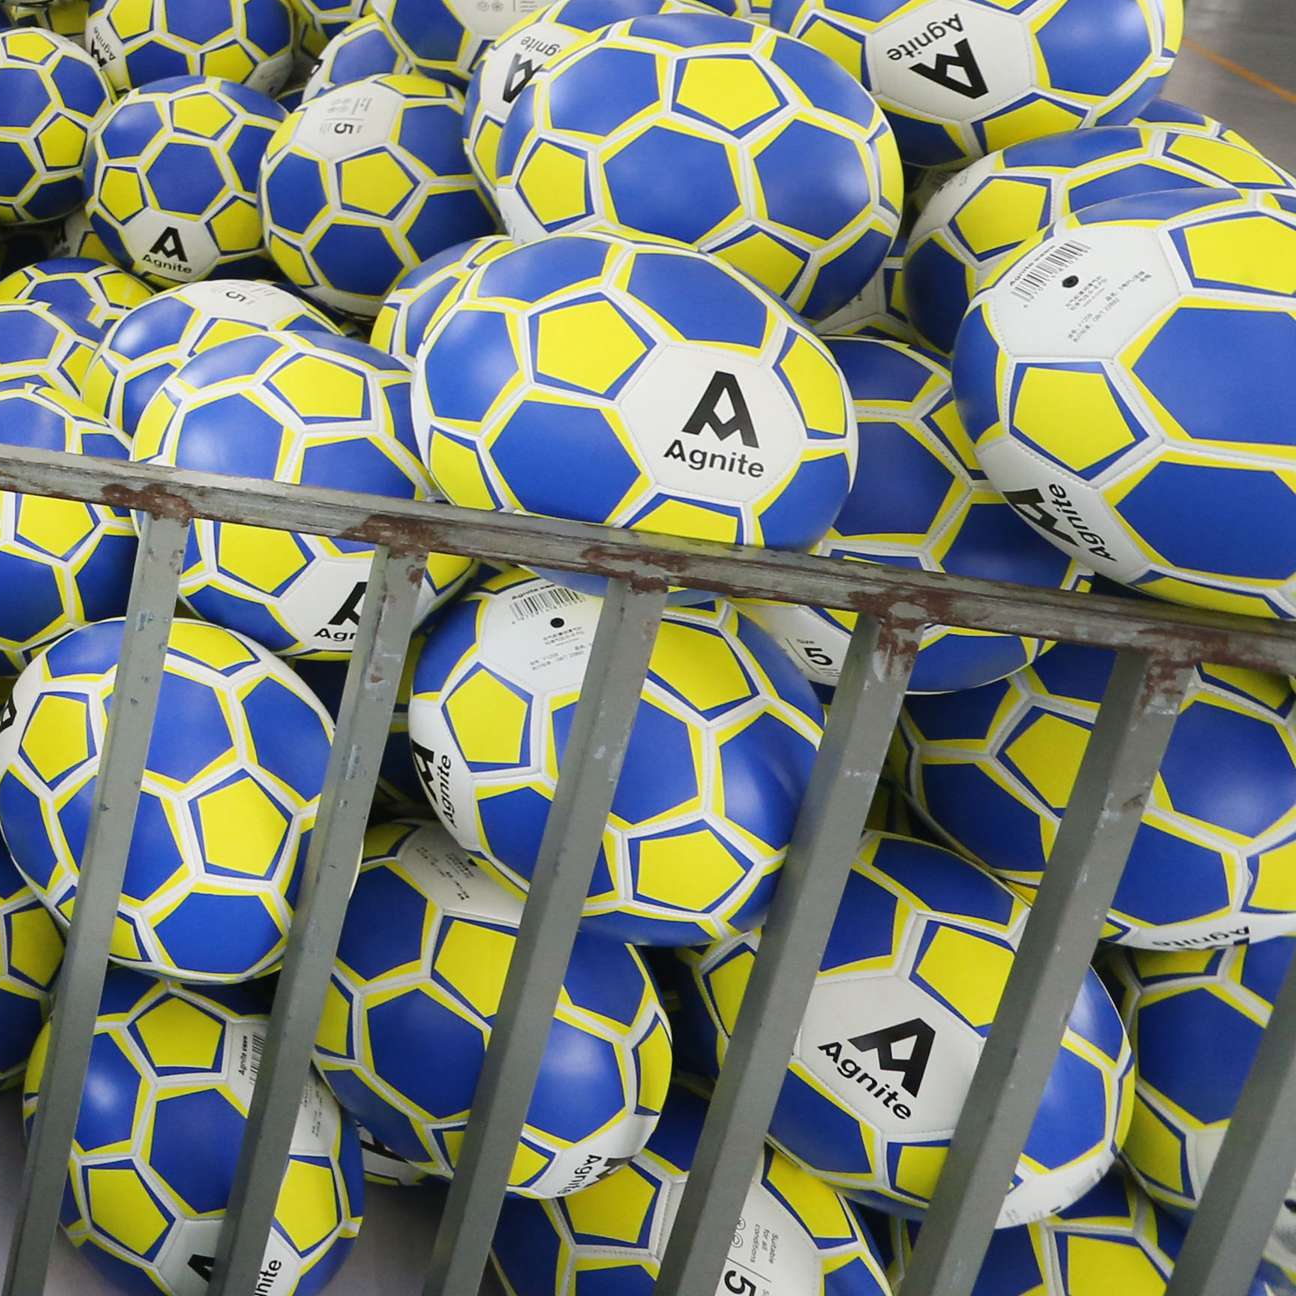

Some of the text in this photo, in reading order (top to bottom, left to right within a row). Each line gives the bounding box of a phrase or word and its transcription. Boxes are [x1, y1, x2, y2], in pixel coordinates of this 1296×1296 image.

[520, 35, 562, 57] gnite
[886, 13, 964, 61] Agnite
[334, 122, 354, 134] 5
[142, 254, 193, 274] Agnite
[663, 439, 765, 478] Agnite
[1048, 483, 1118, 562] Agnite
[804, 647, 833, 666] 5
[436, 755, 458, 829] Agnite
[817, 1041, 912, 1120] Agnite
[724, 1270, 757, 1296] 5
